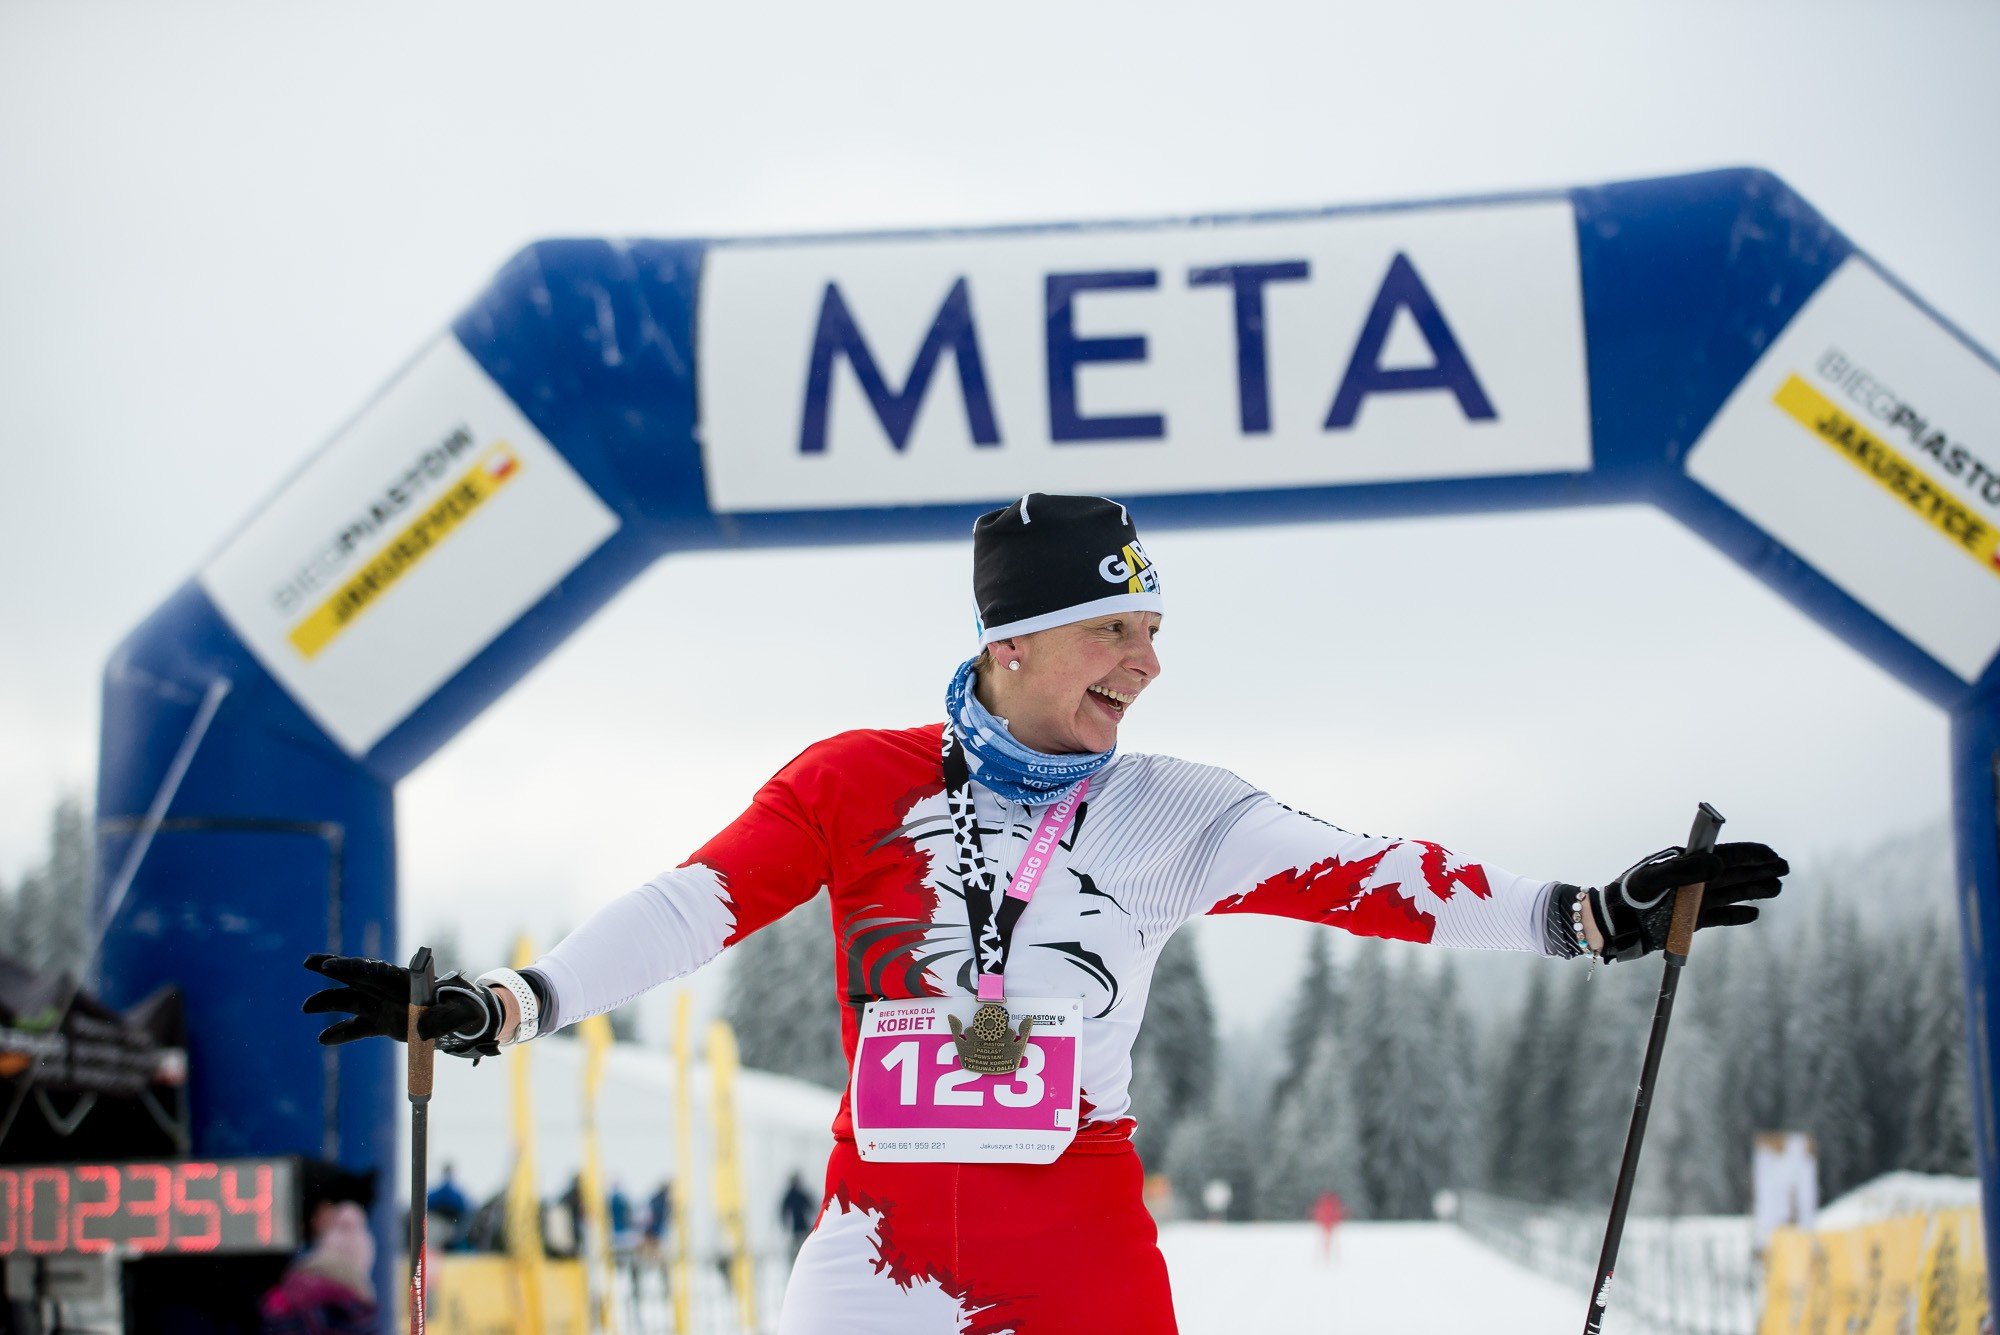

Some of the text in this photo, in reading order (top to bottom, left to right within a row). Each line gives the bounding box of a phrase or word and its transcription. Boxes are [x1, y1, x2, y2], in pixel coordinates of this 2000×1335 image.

[797, 250, 1499, 454] META
[1816, 346, 2000, 505] BIEGPIAST
[1816, 412, 1985, 549] JAKUSZYCE
[1015, 857, 1042, 893] BIEG
[1034, 825, 1060, 855] DLA
[1051, 780, 1086, 823] KOBIE
[877, 1017, 935, 1032] KOBIET
[879, 1010, 895, 1018] BIEG
[921, 1007, 935, 1015] DLA
[880, 1041, 1046, 1107] 123
[878, 1142, 946, 1150] 0048 661 959 221
[1015, 1143, 1055, 1151] 13.01.2018
